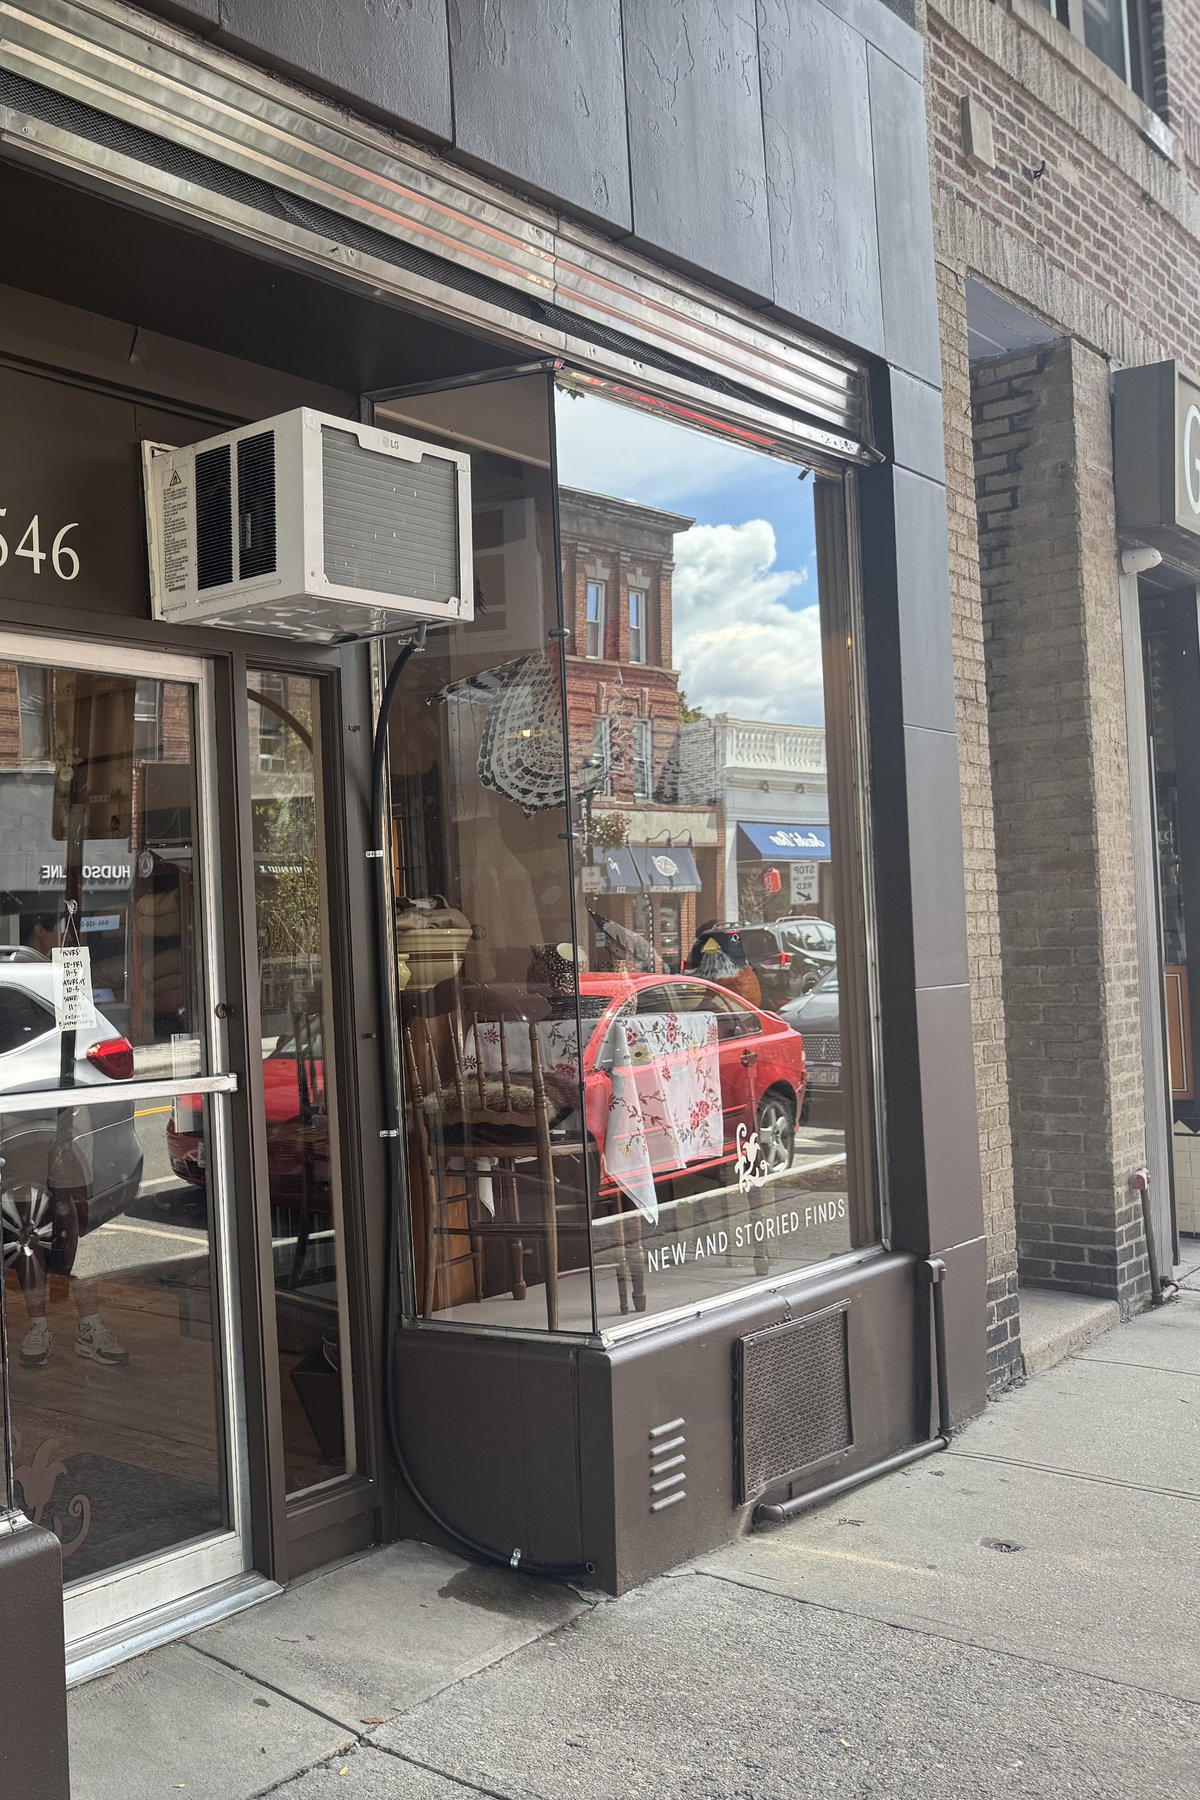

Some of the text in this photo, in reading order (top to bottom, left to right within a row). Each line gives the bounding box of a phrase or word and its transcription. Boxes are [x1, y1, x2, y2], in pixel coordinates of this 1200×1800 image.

[390, 439, 399, 449] LG
[647, 1198, 846, 1274] NEW AND STORIED FINDS
